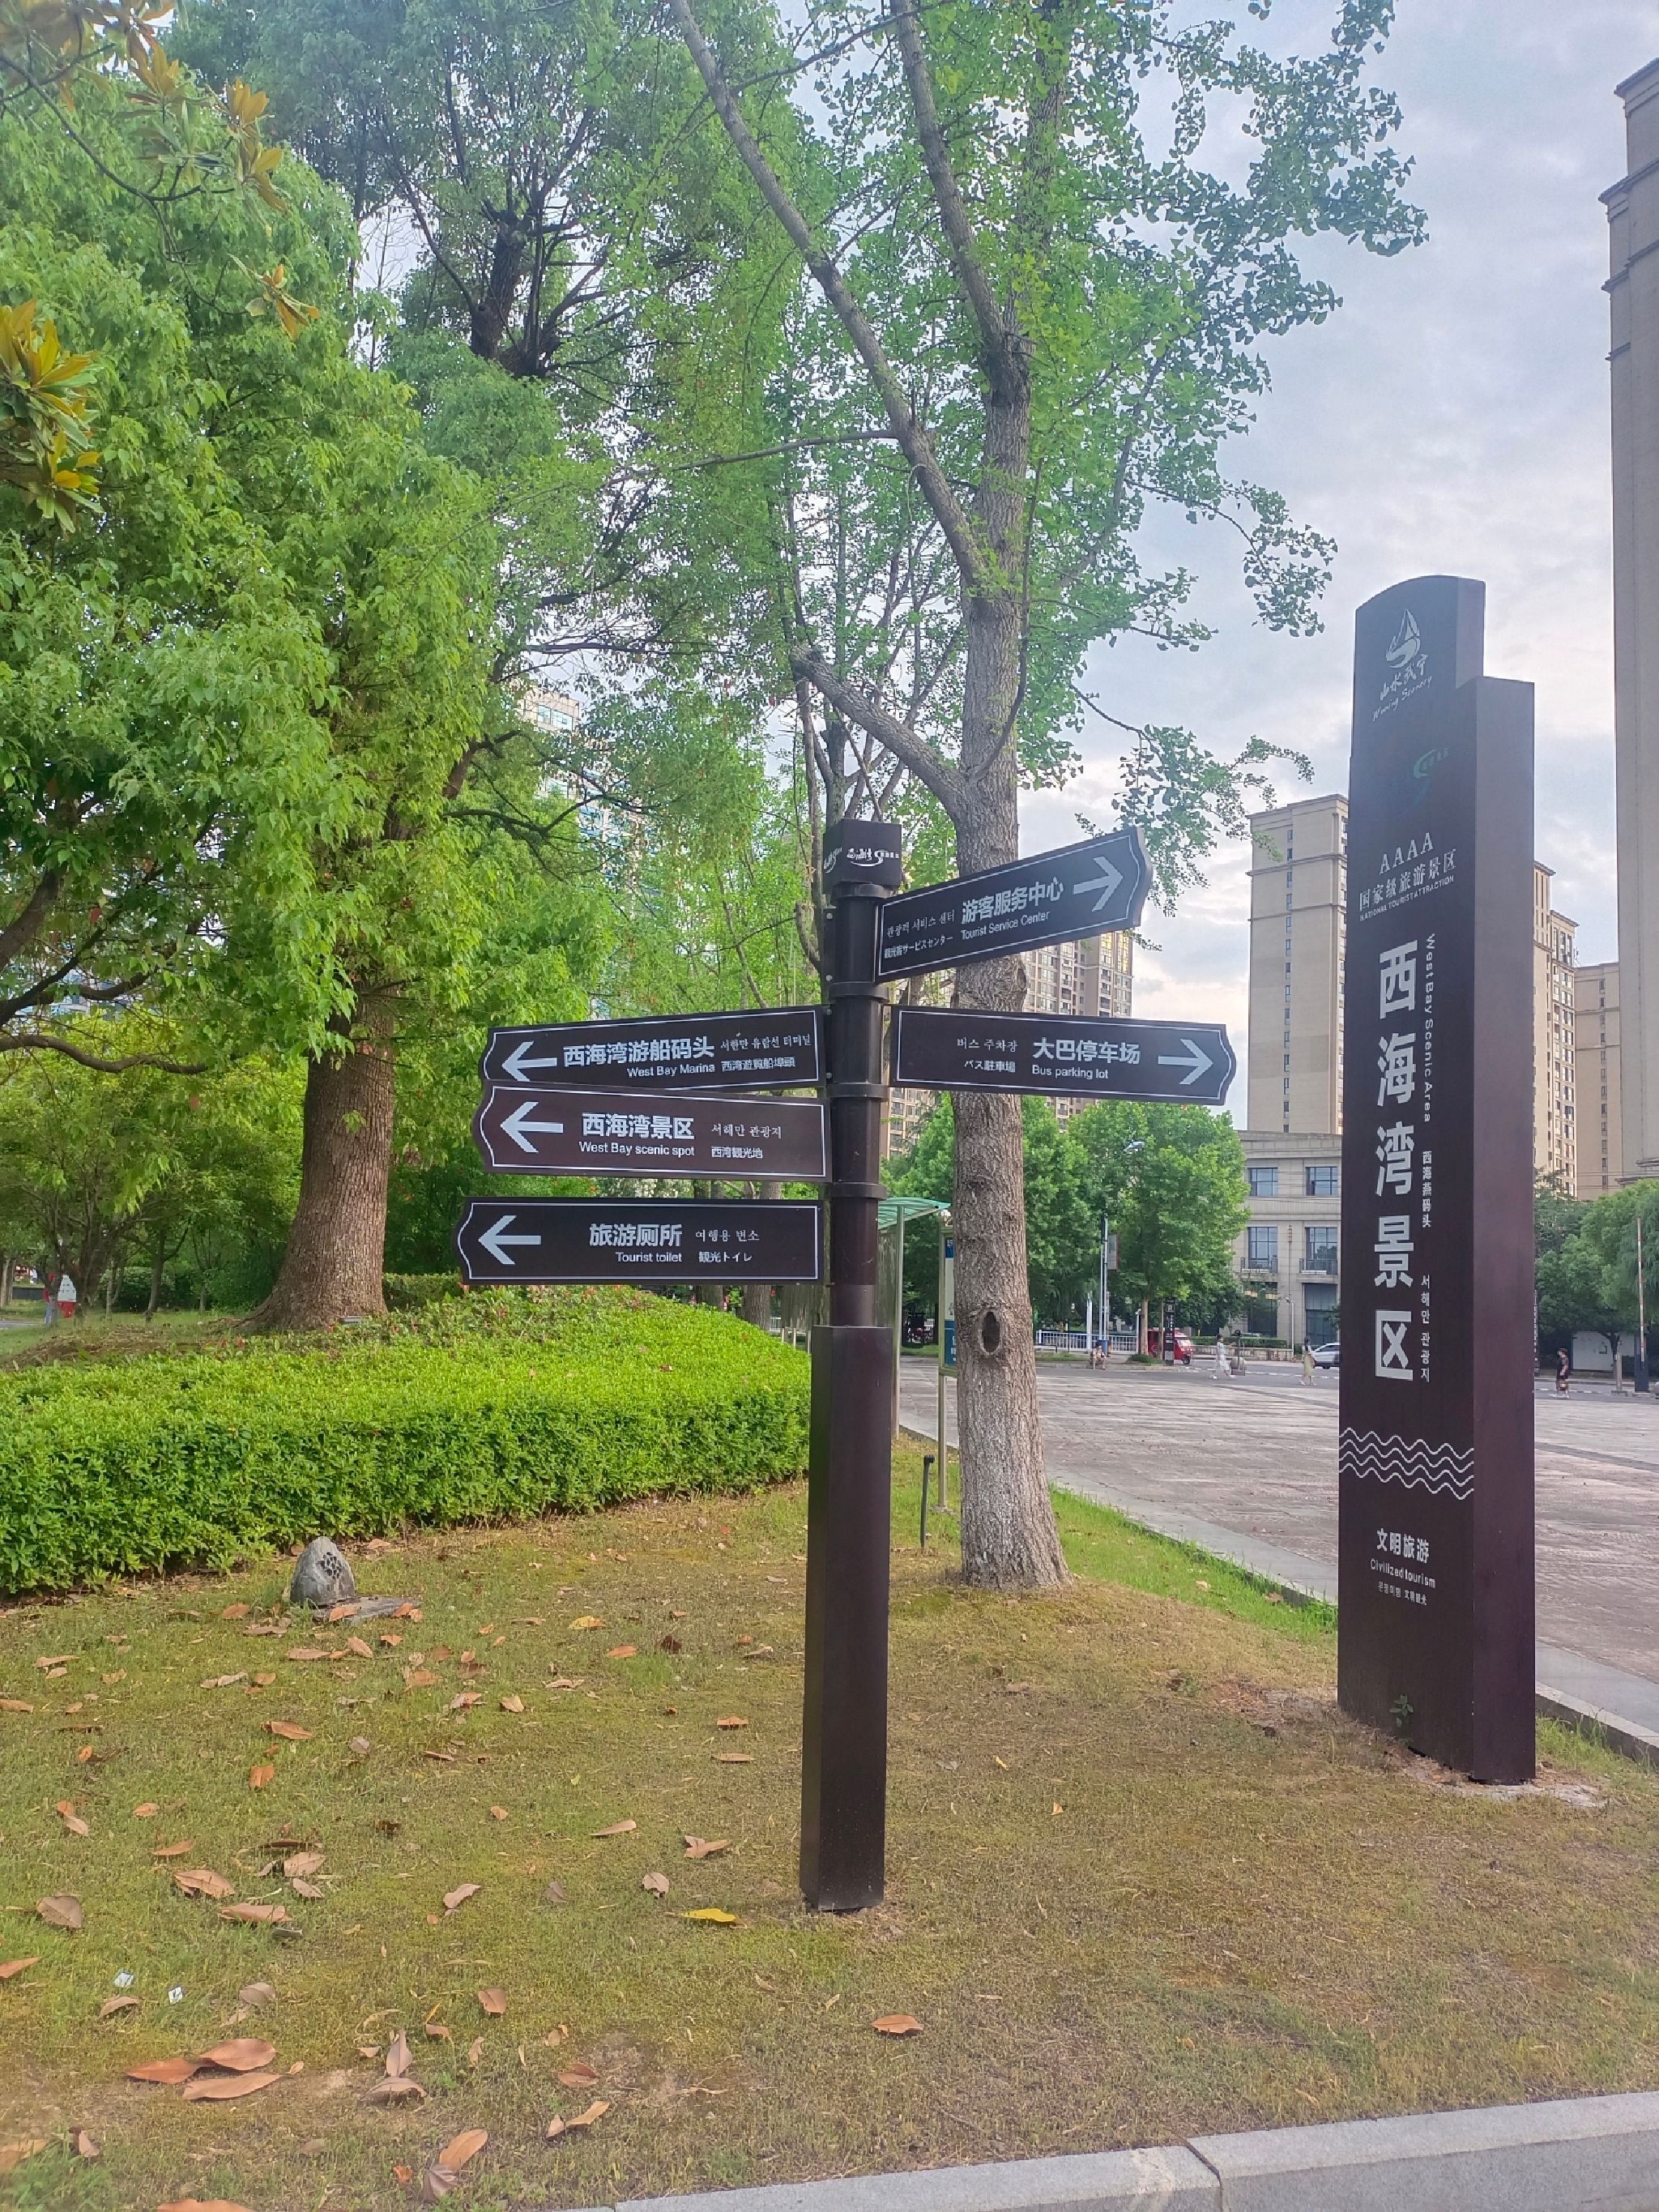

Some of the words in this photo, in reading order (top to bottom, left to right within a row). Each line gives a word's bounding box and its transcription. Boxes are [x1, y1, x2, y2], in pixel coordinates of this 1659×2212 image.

[1380, 831, 1434, 875] AAAA
[1359, 848, 1456, 912] 国家级旅游景区
[961, 876, 1064, 925] 游客服务中心
[961, 926, 987, 941] Tourist
[989, 918, 1018, 933] Service
[1021, 911, 1051, 925] Center
[1425, 933, 1435, 979] West
[1424, 981, 1434, 1014] Bay
[562, 1036, 715, 1067] 西海湾游船码头
[957, 1037, 979, 1050] 버스
[983, 1038, 1018, 1053] 주차장
[1032, 1037, 1141, 1065] 大巴停车场
[1424, 1019, 1434, 1078] Scenic
[627, 1066, 655, 1078] West
[657, 1065, 677, 1078] Bay
[680, 1063, 715, 1074] Marina
[1032, 1064, 1052, 1076] Bus
[1055, 1065, 1094, 1080] parking
[1095, 1068, 1109, 1079] lot
[1423, 1082, 1433, 1122] Area
[582, 1112, 694, 1140] 西海湾景区
[748, 1125, 783, 1139] 관광지
[579, 1141, 608, 1153] West
[611, 1142, 633, 1156] Bay
[635, 1144, 670, 1155] scenic
[672, 1146, 695, 1158] spot
[1374, 940, 1419, 1382] 西海湾景区
[589, 1223, 682, 1247] 旅游厕所
[616, 1252, 653, 1262] Tourist
[655, 1252, 682, 1262] toilet
[698, 1251, 753, 1263] 観光トイレ
[1420, 1274, 1431, 1325] 서해만
[1420, 1331, 1431, 1382] 관광지
[1376, 1527, 1430, 1564] 文明旅游
[1370, 1557, 1404, 1580] Civilized
[1405, 1569, 1436, 1589] tourism
